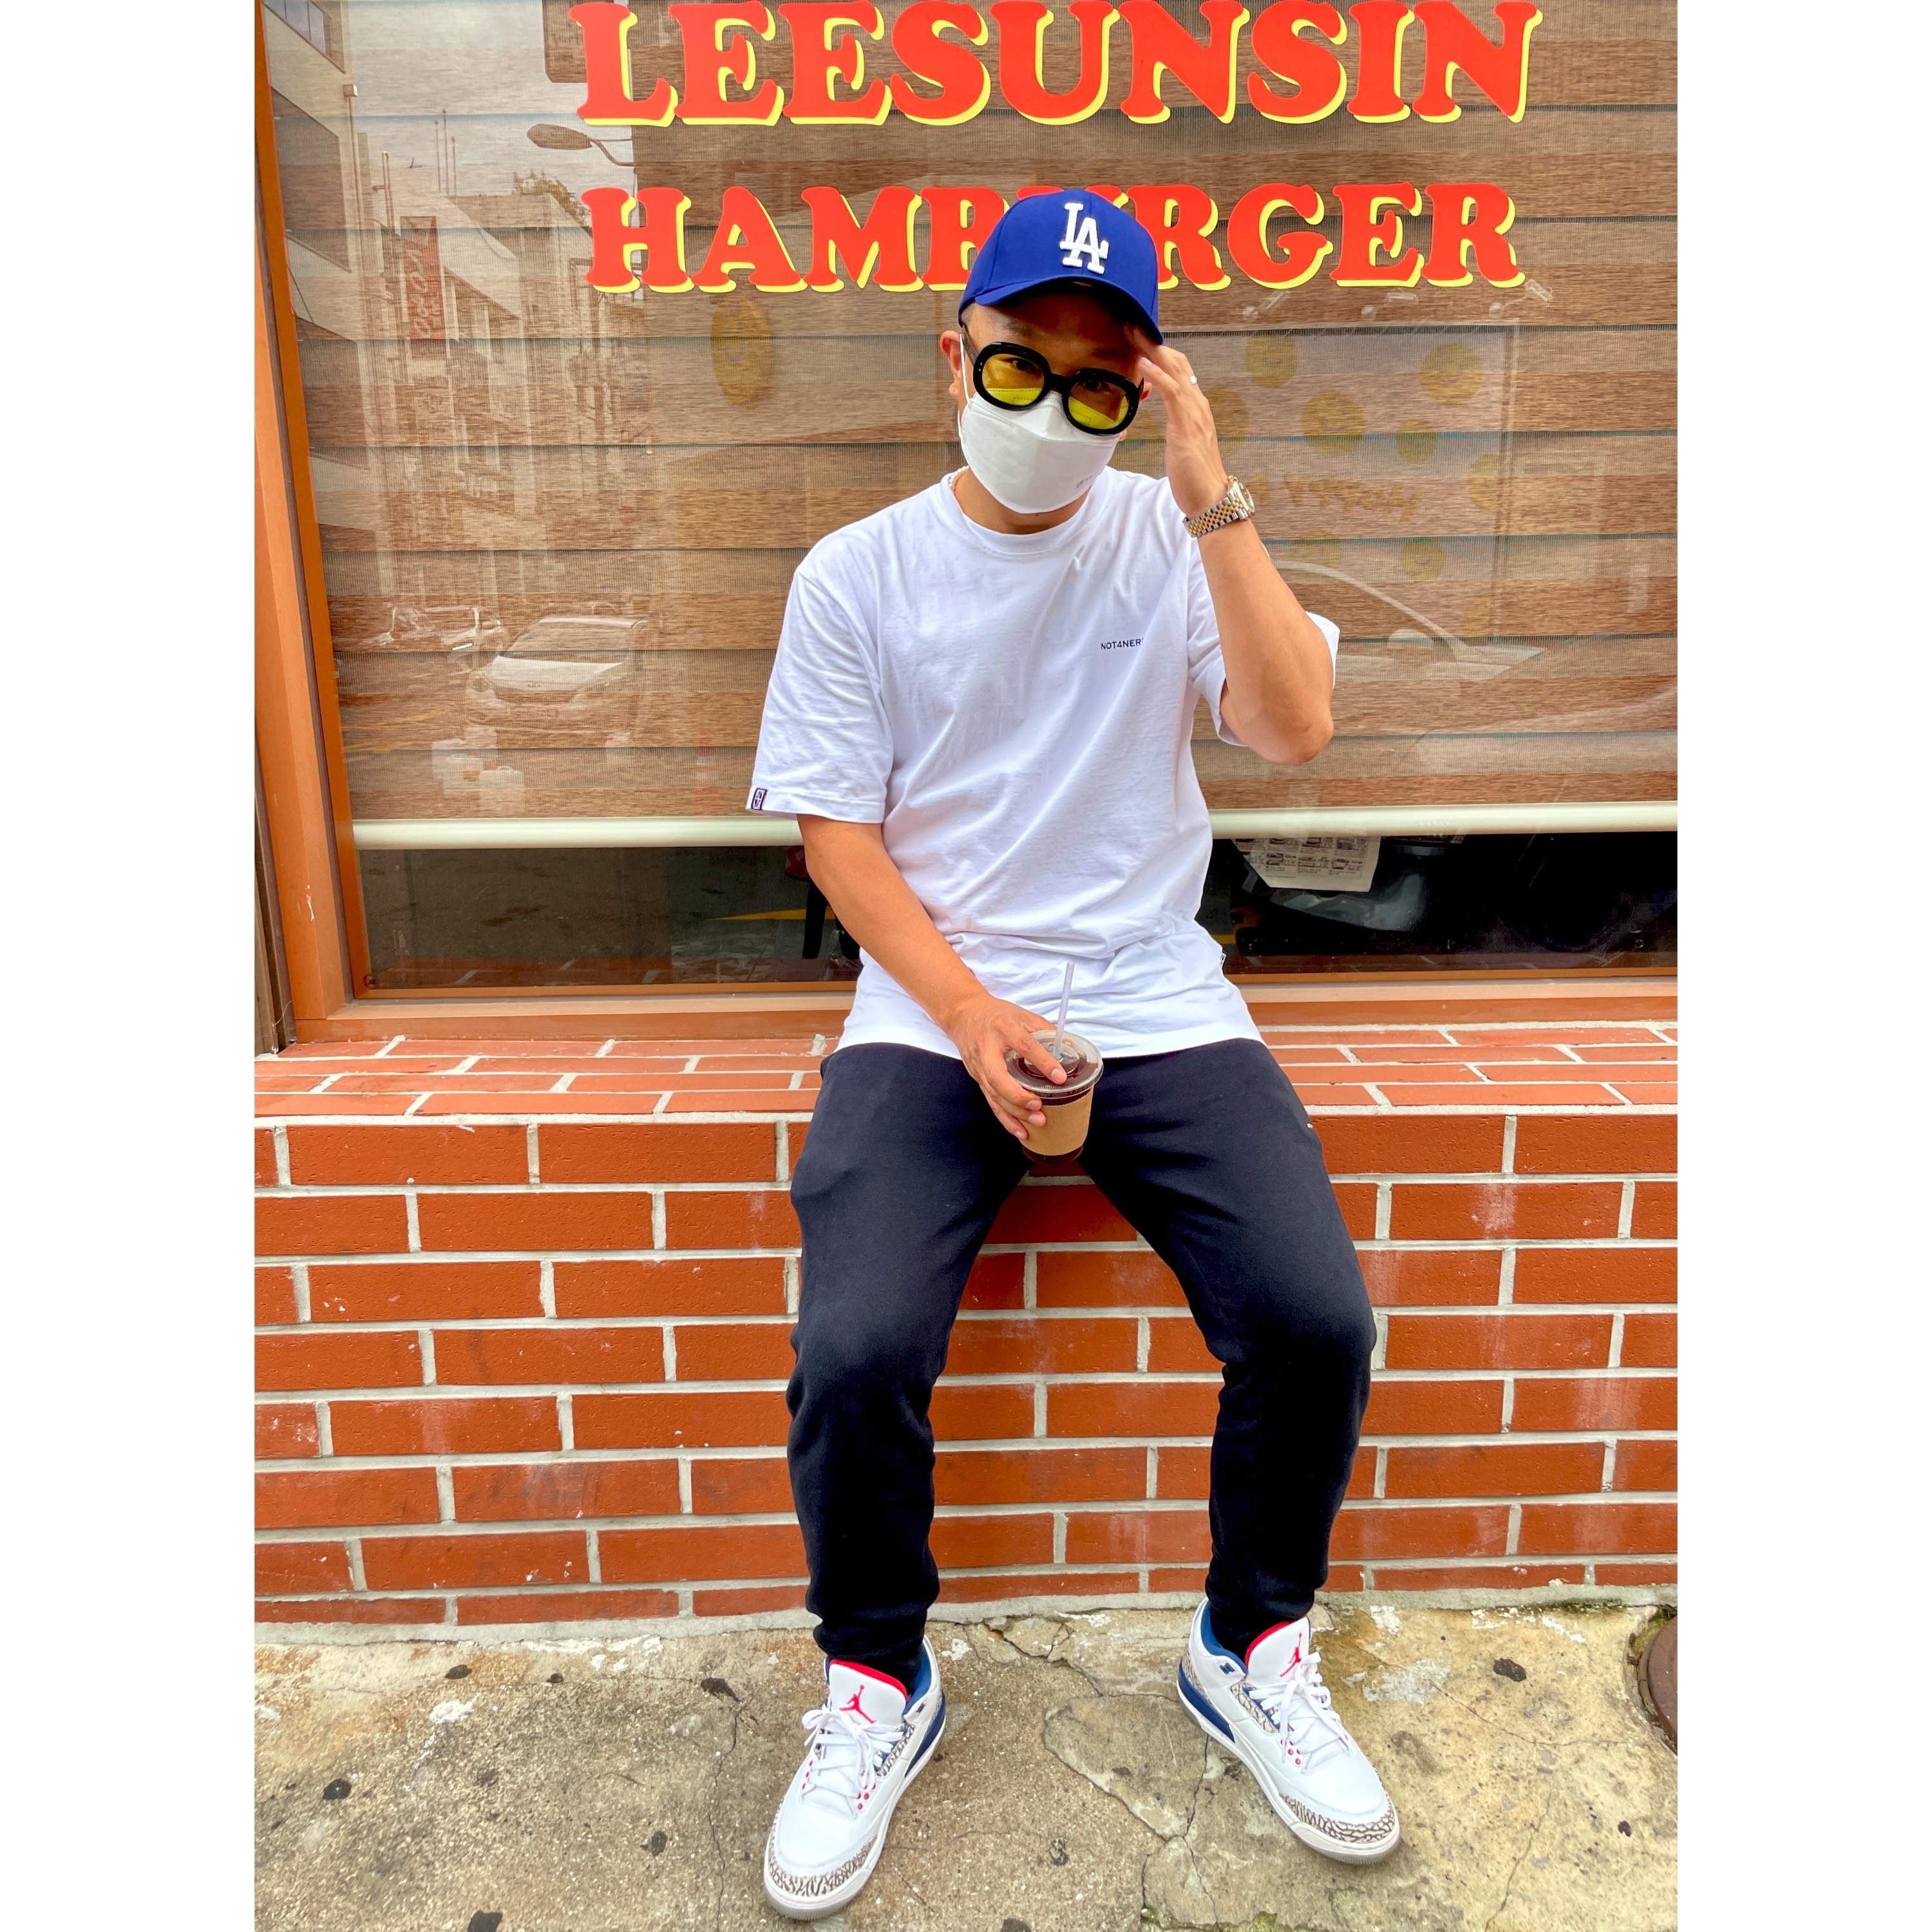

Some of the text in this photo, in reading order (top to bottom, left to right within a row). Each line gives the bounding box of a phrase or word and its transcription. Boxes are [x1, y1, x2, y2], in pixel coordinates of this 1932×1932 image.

[569, 0, 1542, 127] LEESUNSIN
[580, 182, 1526, 294] HAMBRGER
[1059, 202, 1109, 274] LA
[1101, 637, 1144, 650] NOT4NER
